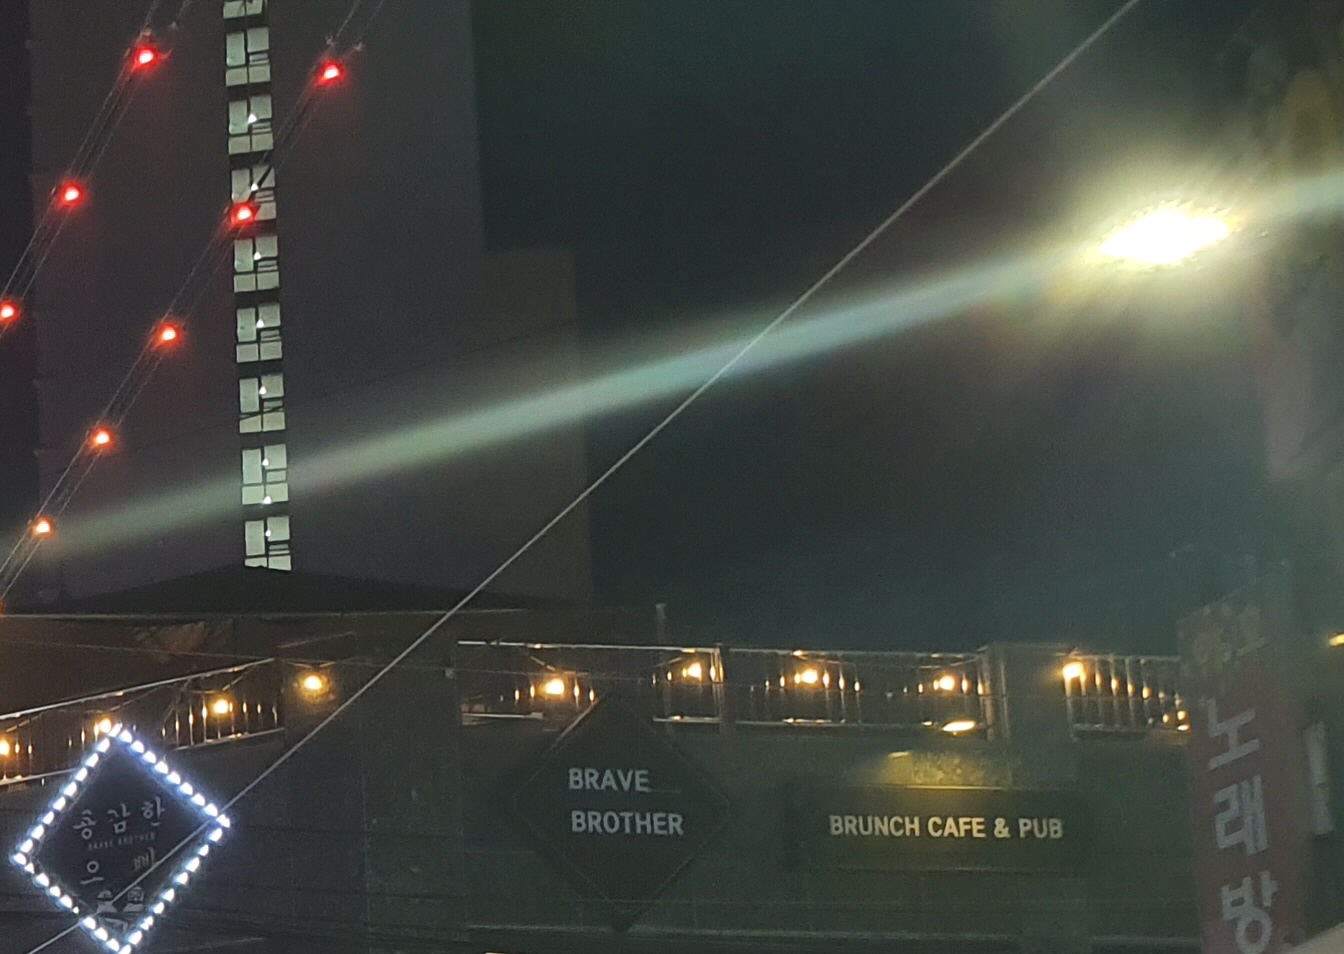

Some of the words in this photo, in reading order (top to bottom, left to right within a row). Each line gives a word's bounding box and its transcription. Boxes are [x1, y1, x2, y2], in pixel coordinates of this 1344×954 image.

[568, 768, 650, 792] BRAVE
[571, 811, 684, 836] BROTHER
[829, 814, 920, 837] BRUNCH
[927, 816, 985, 838] CAFE
[994, 817, 1011, 838] &
[1020, 818, 1063, 839] PUB
